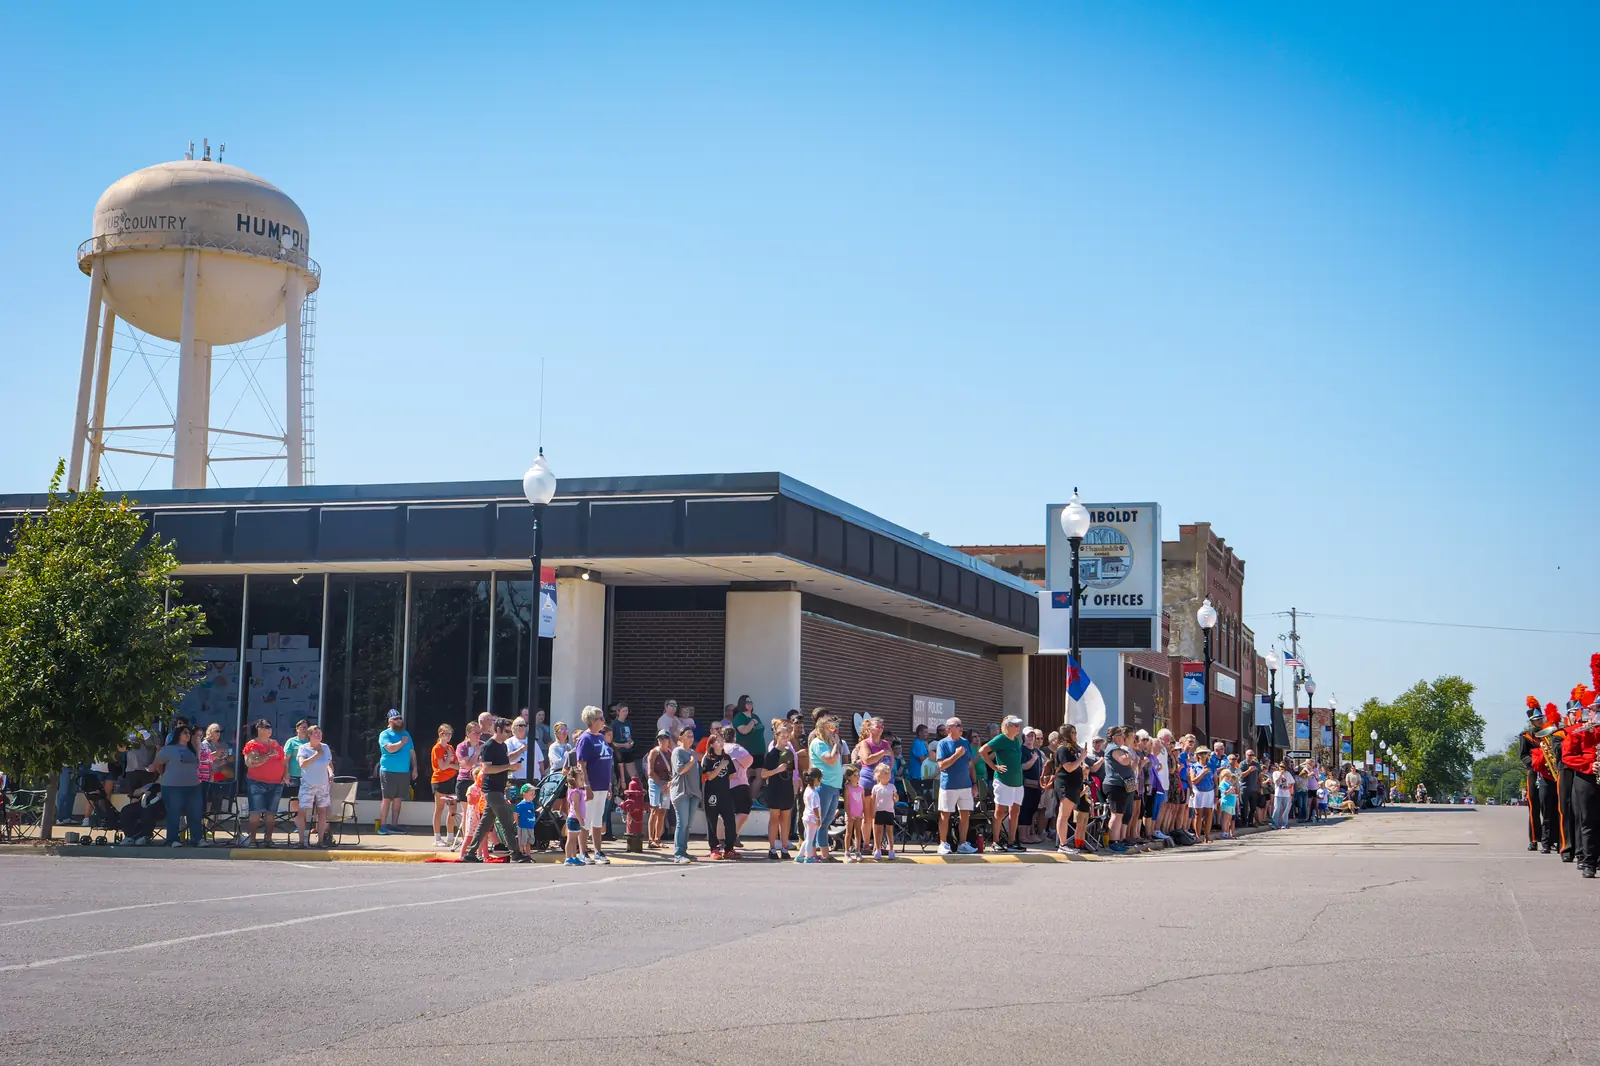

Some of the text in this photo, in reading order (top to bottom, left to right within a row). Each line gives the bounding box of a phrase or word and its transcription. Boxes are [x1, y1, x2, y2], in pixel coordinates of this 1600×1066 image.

[124, 215, 187, 230] COUNTRY
[237, 213, 308, 252] HUMOL
[1089, 511, 1138, 523] MBOLDT
[1094, 594, 1144, 606] OFFICES
[915, 700, 943, 715] CITY POLICE
